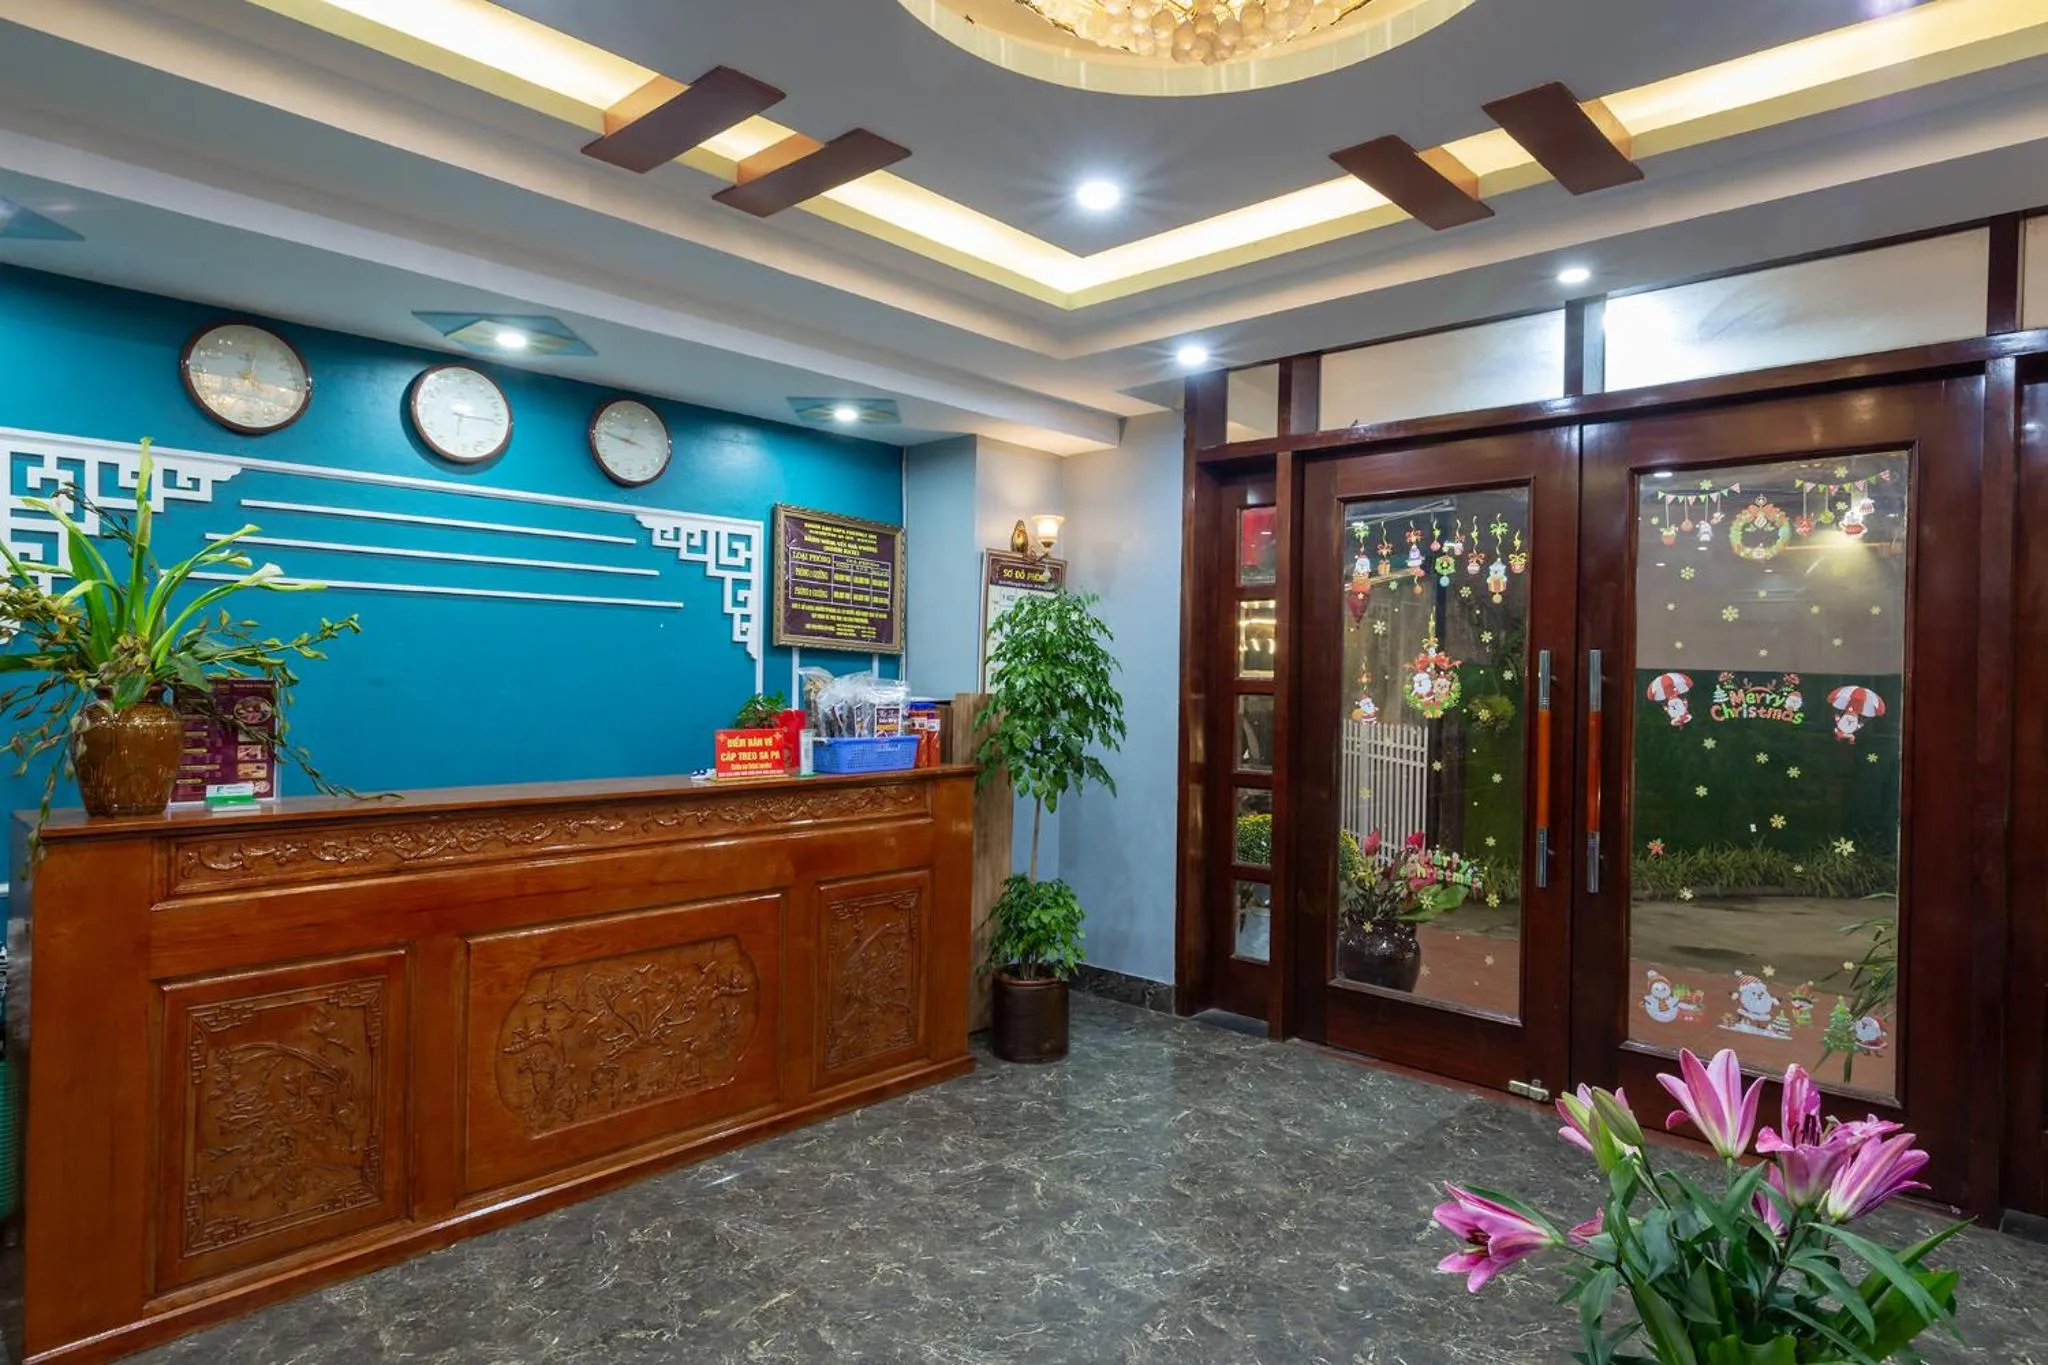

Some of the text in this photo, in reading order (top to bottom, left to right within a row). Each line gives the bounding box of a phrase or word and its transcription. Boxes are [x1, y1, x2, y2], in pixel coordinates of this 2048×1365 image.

[1728, 688, 1786, 708] Merry
[1710, 702, 1804, 725] Christmas
[770, 750, 780, 760] PA
